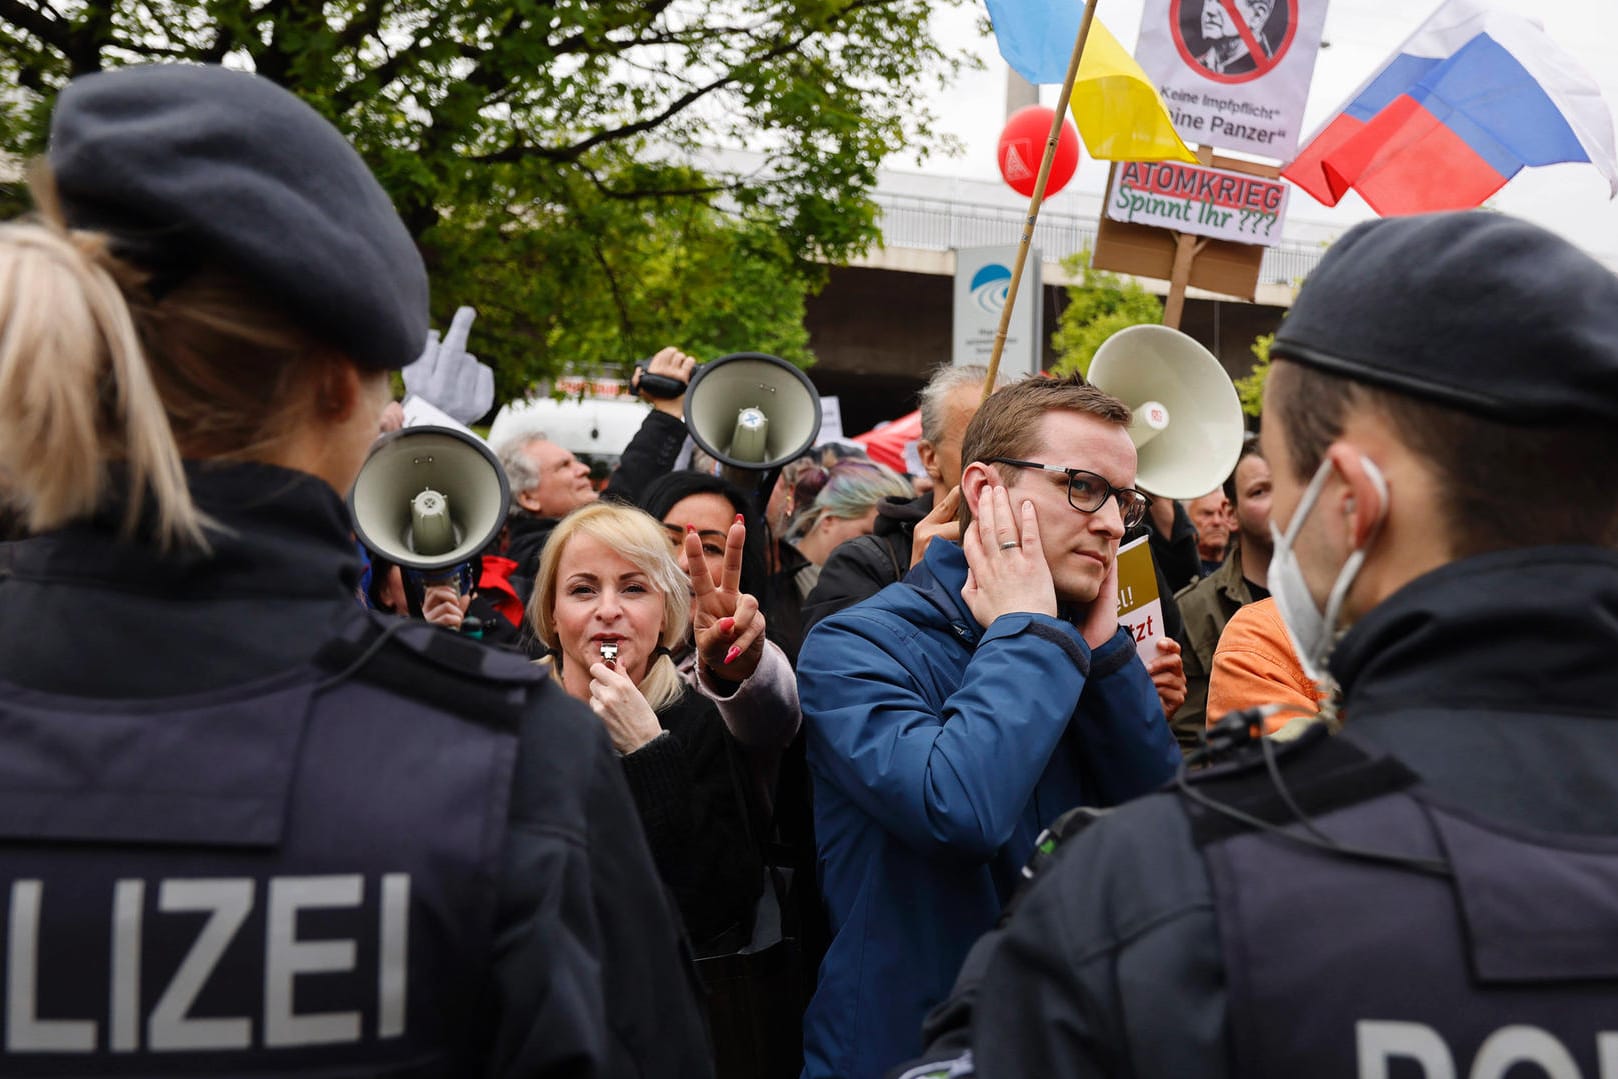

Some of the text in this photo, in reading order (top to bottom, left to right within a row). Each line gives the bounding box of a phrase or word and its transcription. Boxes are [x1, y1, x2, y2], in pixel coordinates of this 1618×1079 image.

[1168, 106, 1204, 130] ine
[1116, 184, 1278, 237] Spinnt Ihr ???
[1121, 161, 1282, 210] ATOMKRIEG
[5, 872, 411, 1053] LIZEI
